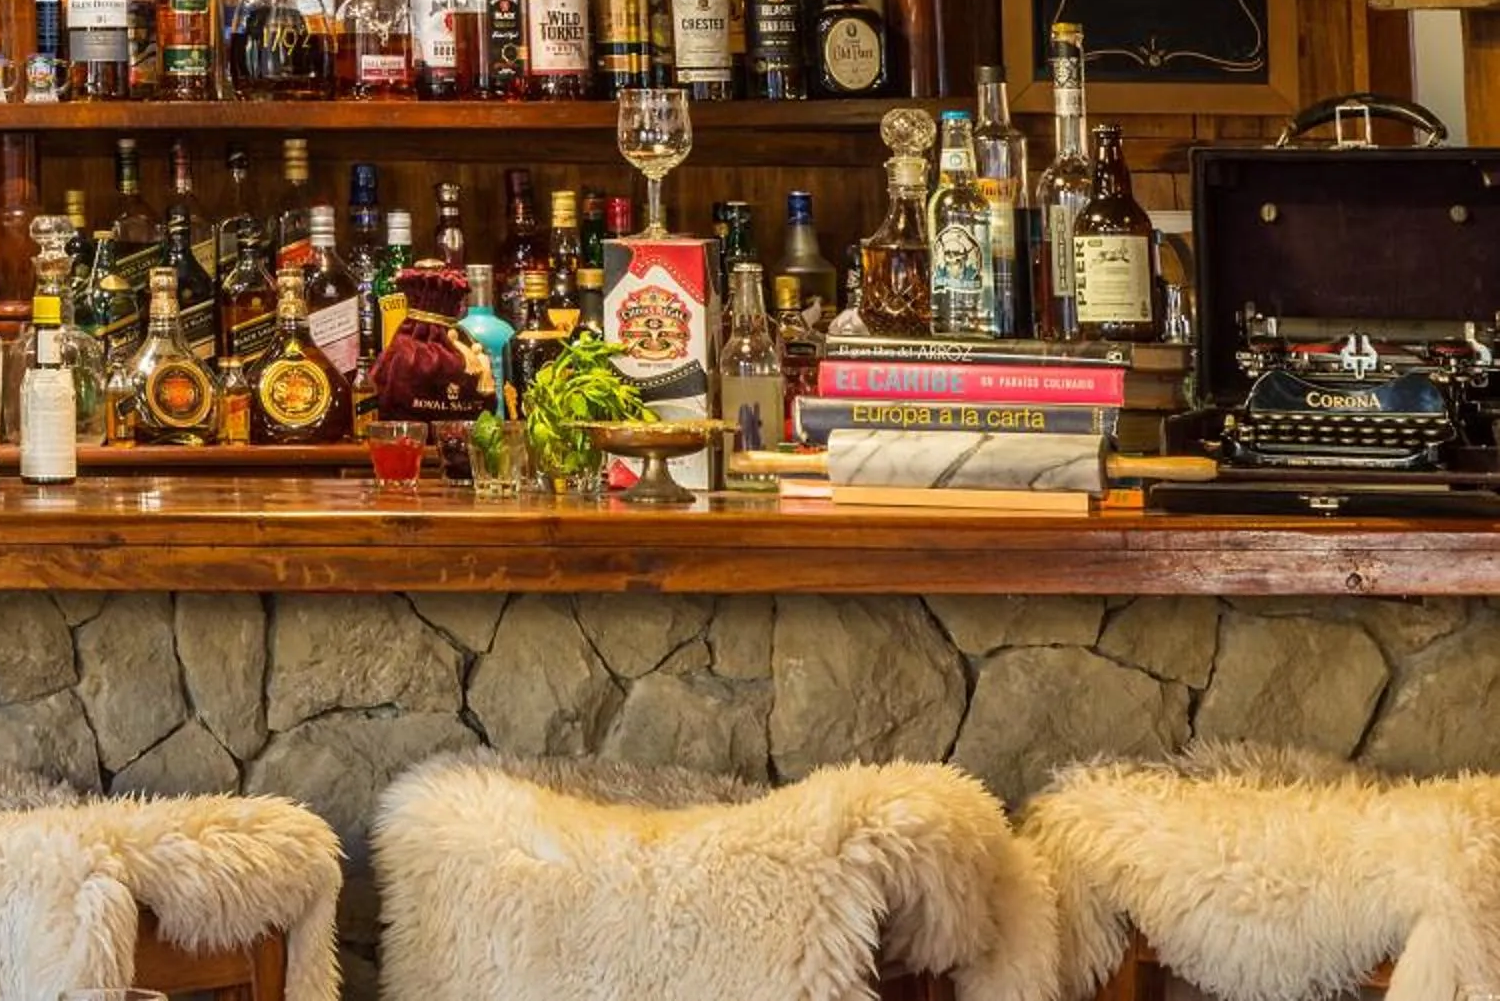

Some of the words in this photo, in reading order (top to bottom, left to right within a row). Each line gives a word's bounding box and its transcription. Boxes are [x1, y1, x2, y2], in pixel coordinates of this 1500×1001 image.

[546, 10, 582, 26] WILD
[538, 22, 585, 42] TURKE
[916, 344, 974, 362] ARROZ
[866, 367, 966, 394] CARIBE
[1305, 390, 1382, 410] CORONA
[852, 404, 932, 427] Europa
[938, 409, 952, 424] a
[960, 406, 980, 425] la
[986, 407, 1046, 429] carta
